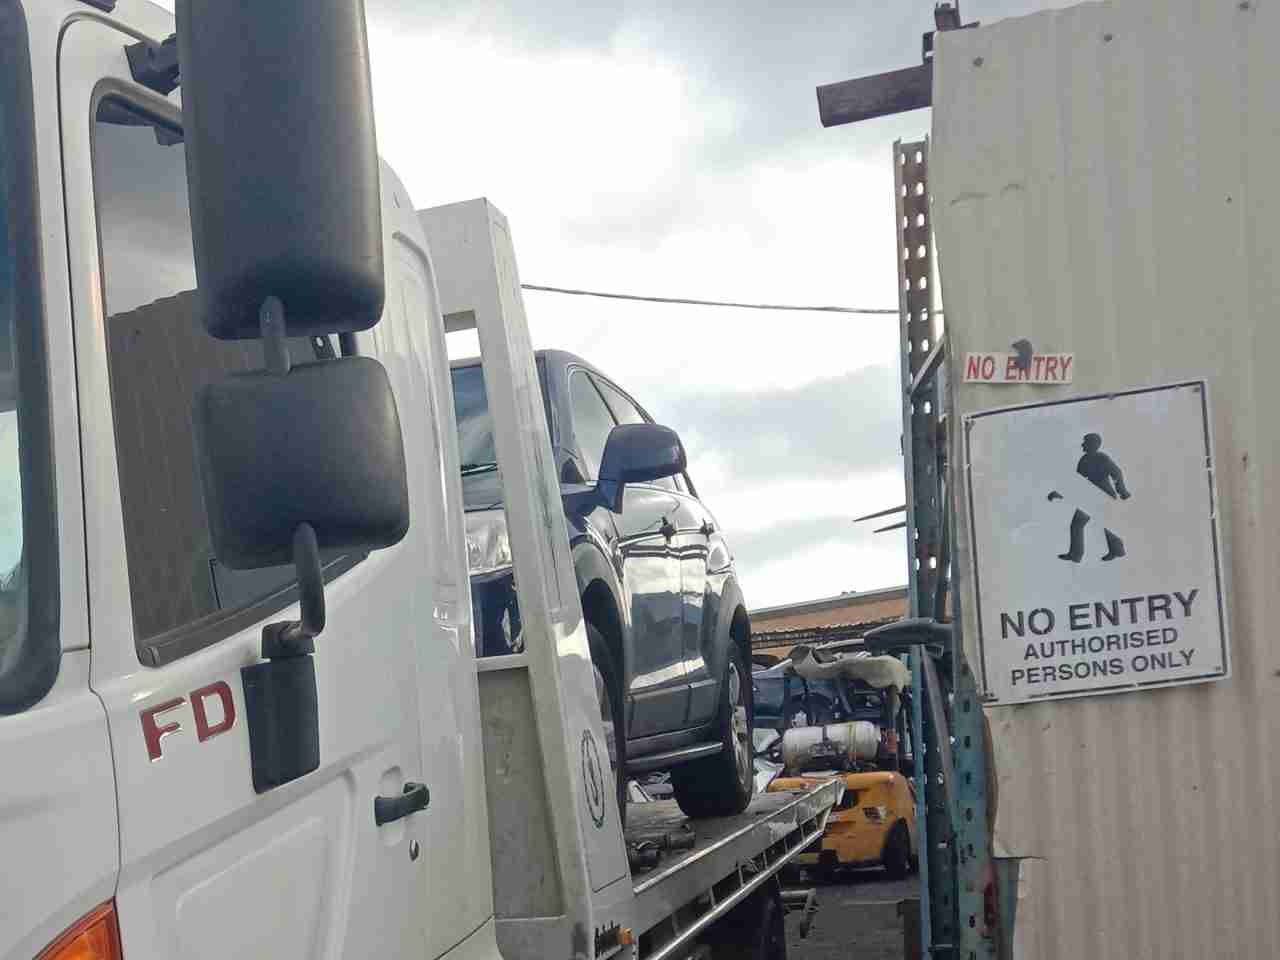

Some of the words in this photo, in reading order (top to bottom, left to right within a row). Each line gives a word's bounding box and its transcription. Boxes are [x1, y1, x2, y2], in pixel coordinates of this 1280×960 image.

[967, 356, 995, 381] NO
[1005, 355, 1073, 381] ENTRY
[1000, 607, 1056, 640] NO
[1069, 588, 1200, 631] ENTRY
[1023, 627, 1179, 661] AUTHORISED
[1011, 656, 1124, 686] PERSONS
[1132, 648, 1196, 673] ONLY
[139, 680, 237, 763] FD
